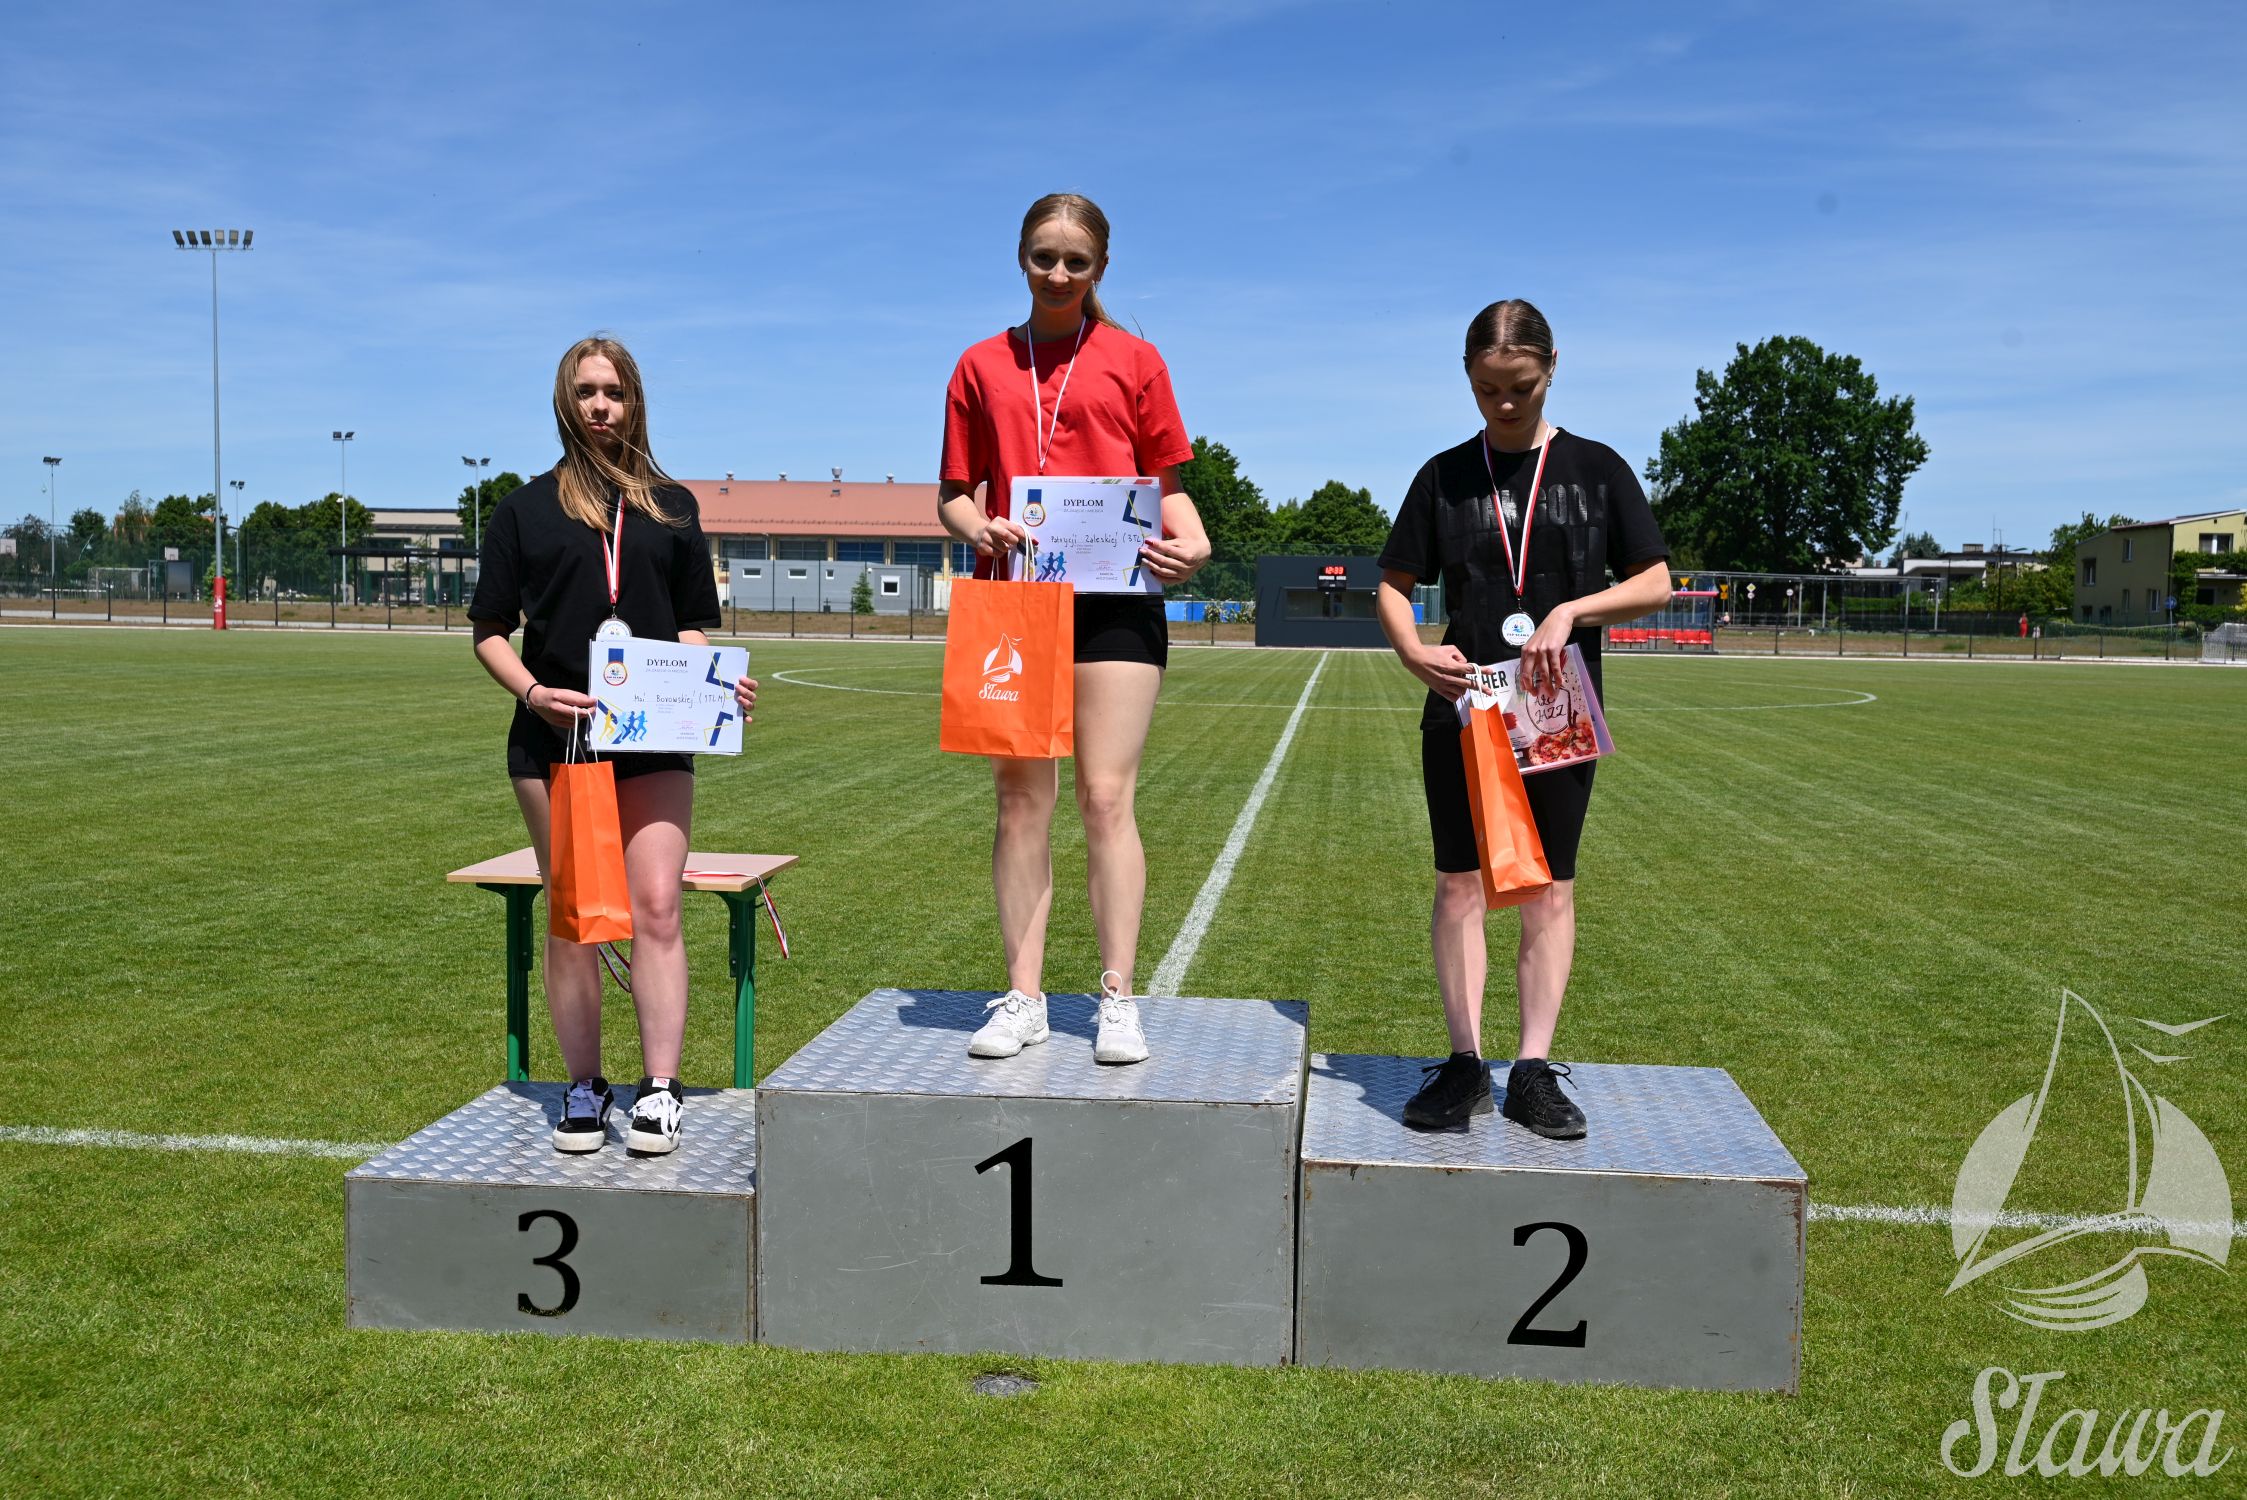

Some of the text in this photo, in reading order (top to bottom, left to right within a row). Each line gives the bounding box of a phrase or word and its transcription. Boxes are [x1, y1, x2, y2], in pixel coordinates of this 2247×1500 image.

[1063, 499, 1104, 507] DYPLOM
[1085, 531, 1118, 548] Zaleskiej
[646, 658, 688, 668] DYPLOM
[656, 690, 696, 708] Borowskiej
[974, 1137, 1063, 1287] 1
[517, 1209, 581, 1317] 3
[1507, 1221, 1588, 1348] 2
